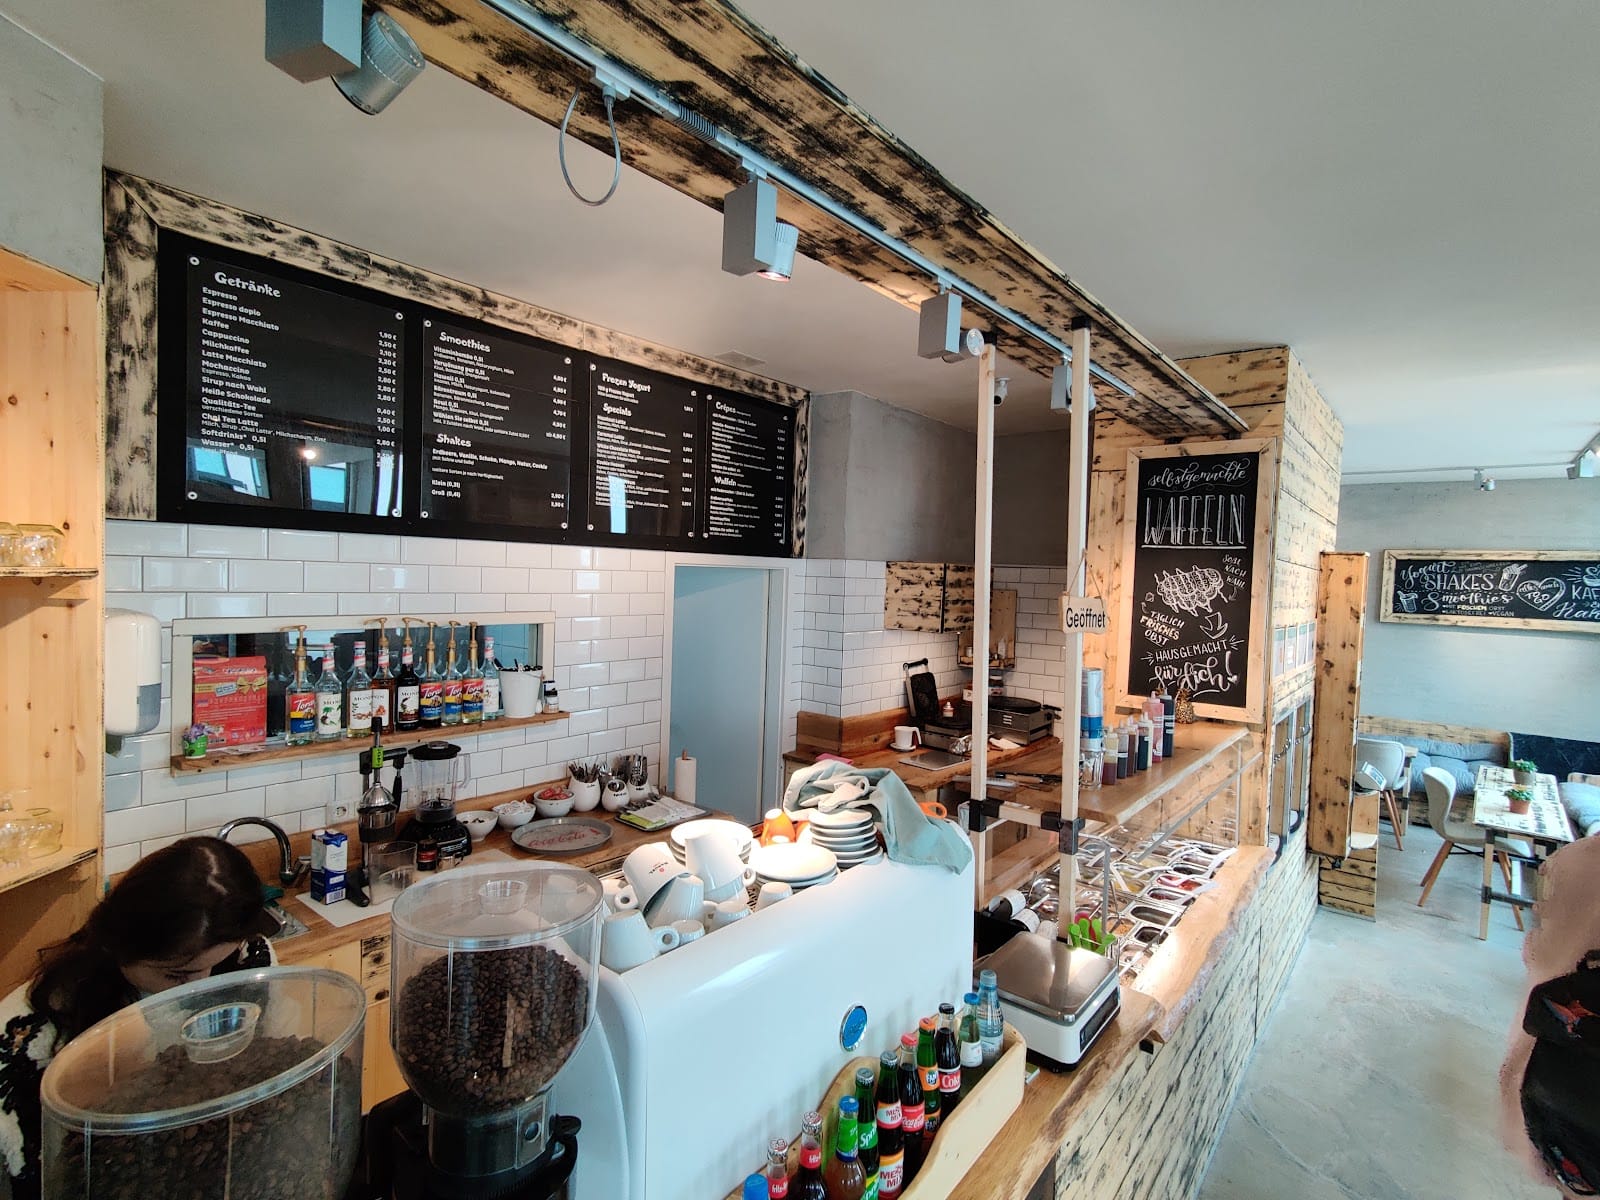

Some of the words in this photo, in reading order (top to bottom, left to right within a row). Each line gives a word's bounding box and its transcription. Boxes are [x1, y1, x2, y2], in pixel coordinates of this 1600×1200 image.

[215, 272, 280, 297] Getränke
[202, 287, 237, 301] Espresso
[202, 297, 237, 311] Espresso
[202, 308, 237, 321] Espresso
[239, 316, 279, 331] Macchiato
[202, 318, 229, 330] Kaffee
[202, 328, 250, 344] Cappuccino
[439, 331, 490, 352] Smoothies
[202, 339, 250, 354] Milchkaffee
[202, 350, 224, 361] Latte
[226, 354, 266, 368] Macchiato
[202, 360, 250, 374] Mochaccino
[202, 376, 224, 386] Sirup
[225, 381, 245, 390] nach
[246, 384, 267, 393] Wahl
[202, 387, 225, 396] Heiße
[226, 391, 271, 404] Schokolade
[202, 413, 220, 422] Chai
[222, 415, 236, 424] Tea
[238, 417, 259, 427] Latte
[436, 433, 472, 447] Shakes
[1148, 458, 1250, 489] selbstgemachte
[1144, 494, 1245, 545] WAFFELN
[1425, 573, 1493, 590] SHAKES
[1421, 592, 1513, 611] Smoothies
[1066, 608, 1106, 628] Geöffnet
[1140, 616, 1180, 640] FRISCHES
[1144, 630, 1170, 645] OBST
[1156, 639, 1227, 661] HAUSGEMACHT
